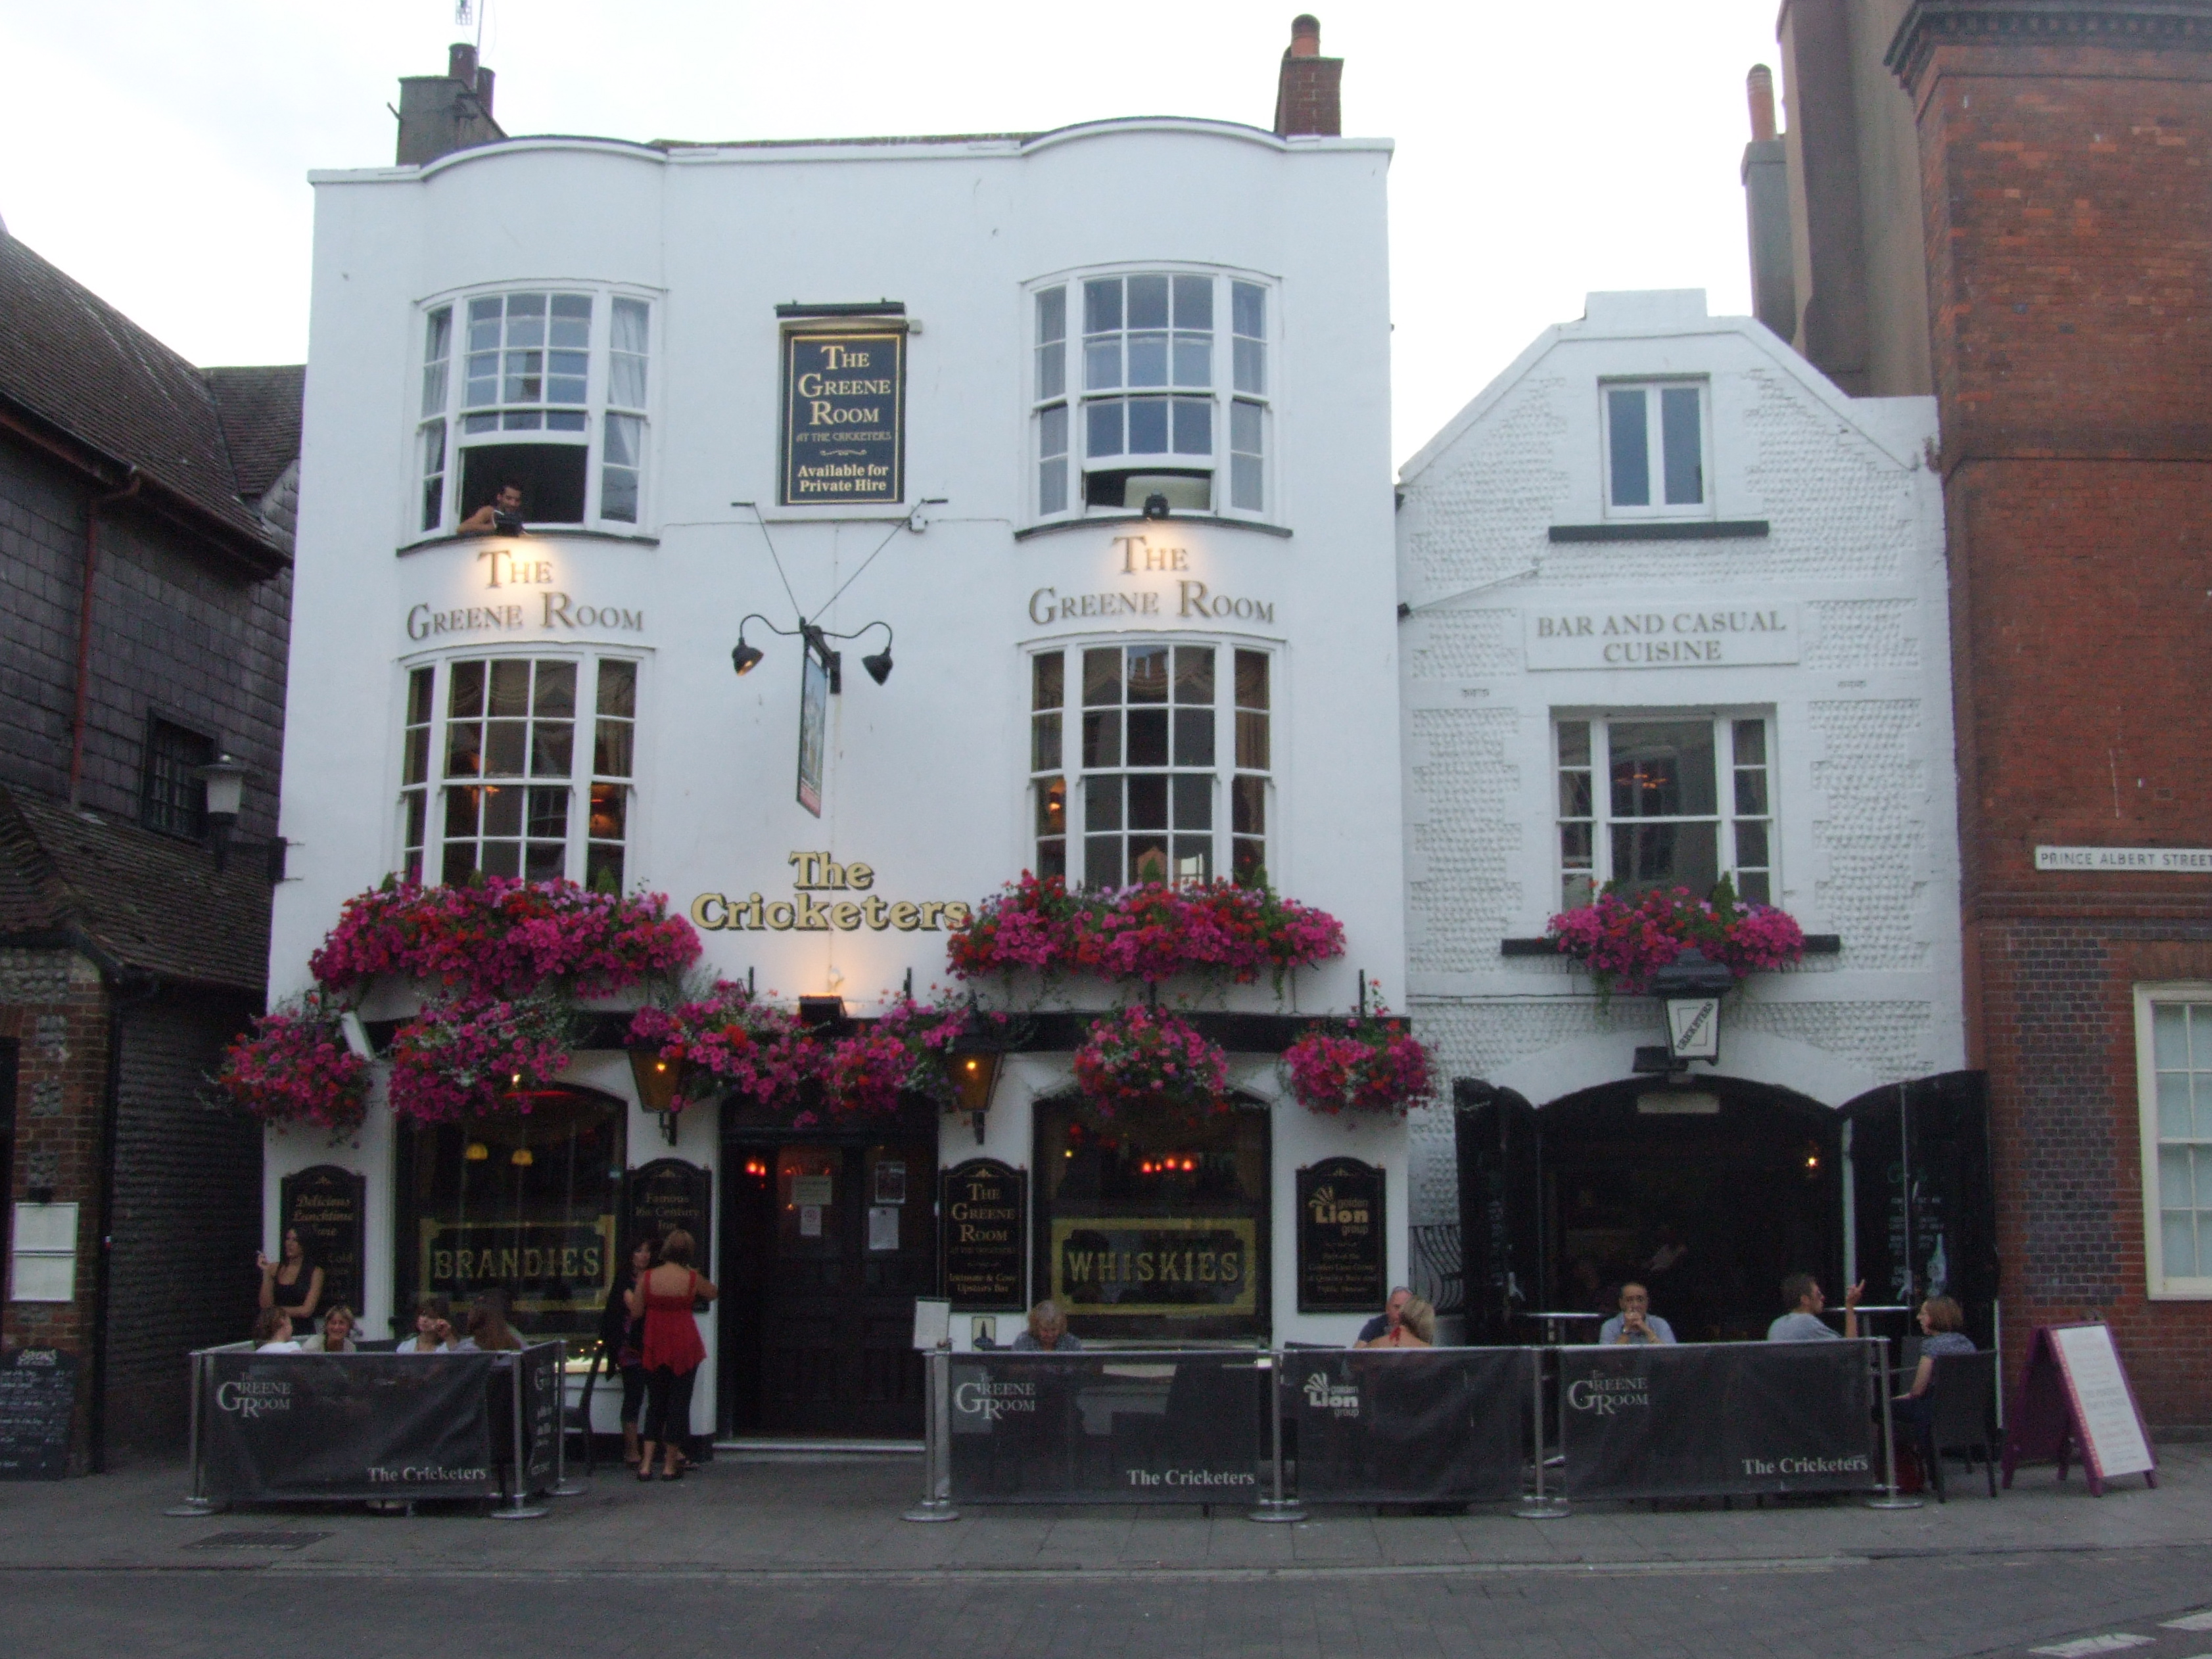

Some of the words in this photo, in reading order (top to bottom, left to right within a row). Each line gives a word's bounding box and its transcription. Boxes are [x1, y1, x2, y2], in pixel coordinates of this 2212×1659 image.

[821, 345, 870, 369] THE
[798, 373, 891, 398] GREENE
[809, 400, 879, 425] ROOM
[797, 464, 864, 478] Available
[867, 464, 889, 477] for
[800, 479, 852, 492] Private
[855, 479, 886, 492] Hire
[1112, 536, 1188, 574] THE
[478, 549, 553, 588] THE
[1029, 587, 1159, 625] GREENE
[1177, 579, 1275, 624] ROOM
[407, 603, 523, 641] GREENE
[540, 591, 644, 632] ROOM
[1537, 616, 1593, 638] BAR
[1603, 614, 1664, 636] AND
[1672, 611, 1786, 634] CASUAL
[1603, 640, 1722, 663] CUISINE
[789, 851, 874, 891] The
[2041, 853, 2092, 865] PRINCE
[2100, 853, 2154, 866] ALBERT
[690, 892, 971, 932] Cricketers
[952, 1203, 1016, 1221] GREENE
[1315, 1203, 1369, 1223] Lion
[960, 1225, 1008, 1242] ROOM
[435, 1248, 600, 1279] BRANDIES
[1068, 1251, 1239, 1282] WHISKIES
[216, 1382, 291, 1411] GREENE
[955, 1382, 1037, 1413] GREENE
[1310, 1390, 1359, 1407] Lion
[1567, 1378, 1647, 1409] GREENE
[1595, 1394, 1648, 1414] ROOM
[241, 1397, 290, 1418] ROOM
[982, 1399, 1035, 1420] ROOM
[367, 1467, 398, 1481] The
[402, 1466, 486, 1480] Cricketers
[1126, 1469, 1160, 1485] The
[1165, 1469, 1255, 1485] Cricketers
[1742, 1458, 1774, 1474] The
[1779, 1457, 1868, 1474] Cricketers
